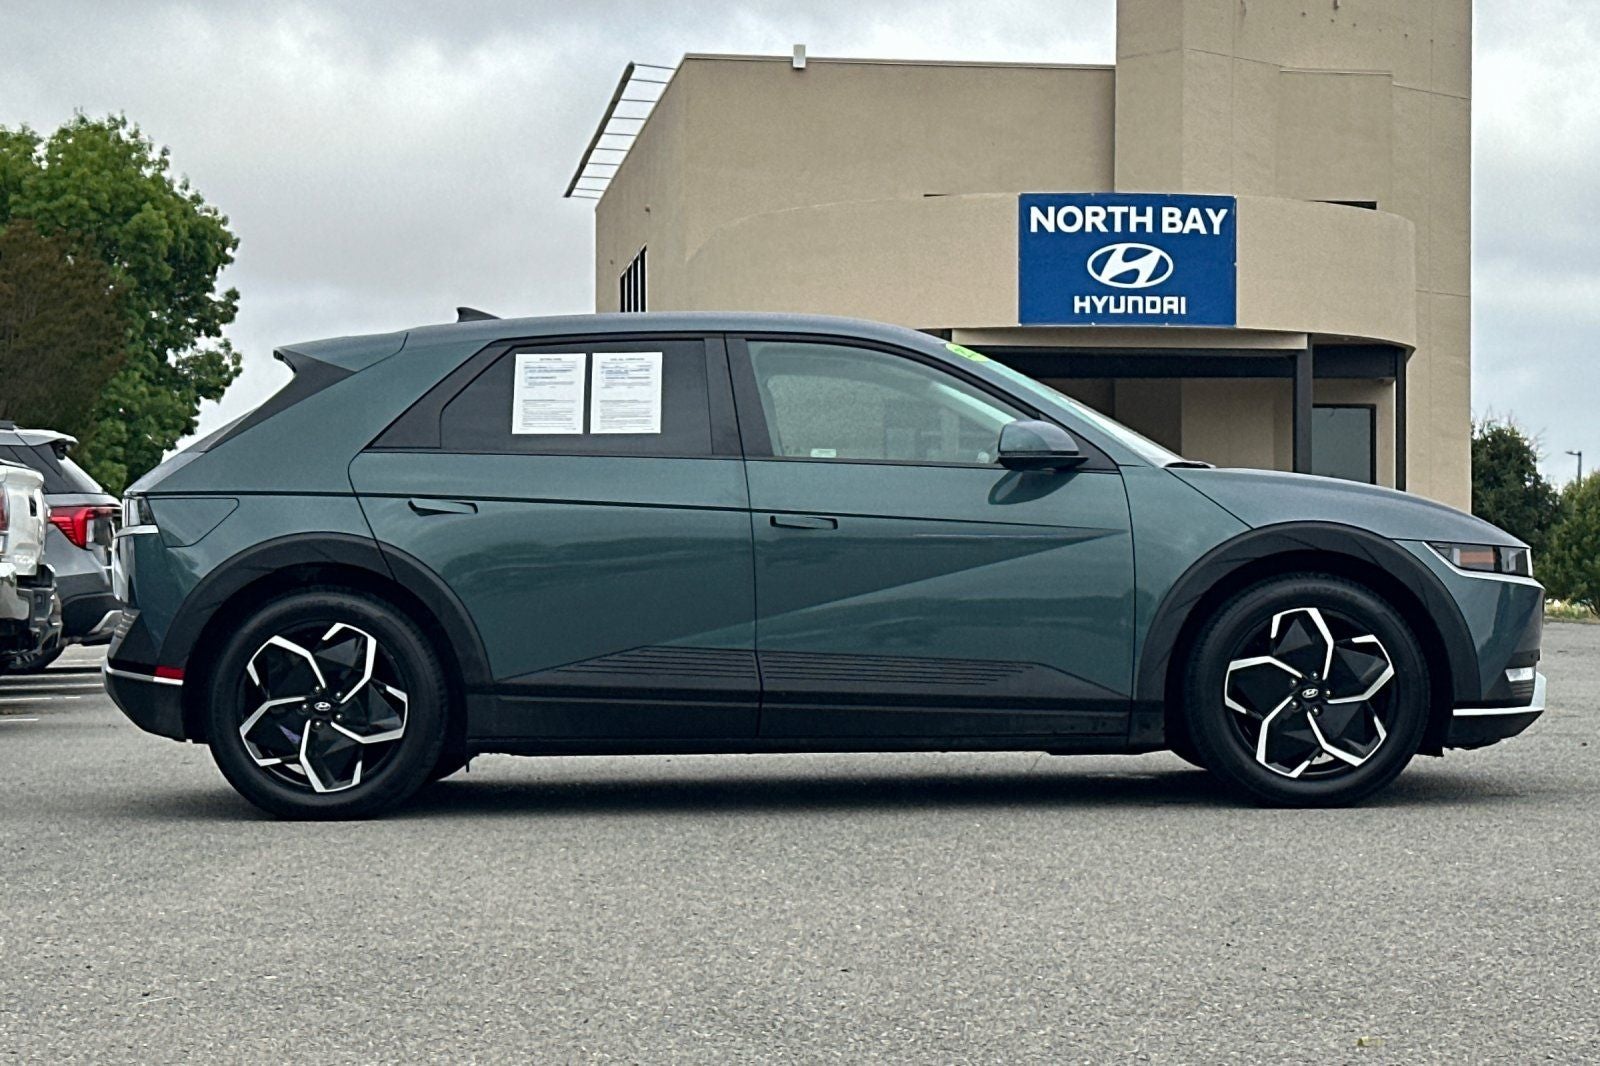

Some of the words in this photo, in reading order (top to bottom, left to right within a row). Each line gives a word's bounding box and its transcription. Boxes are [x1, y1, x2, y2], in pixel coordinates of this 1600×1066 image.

[1030, 205, 1153, 233] NORTH
[1161, 206, 1228, 235] BAY
[1073, 295, 1187, 315] HYUNDAI
